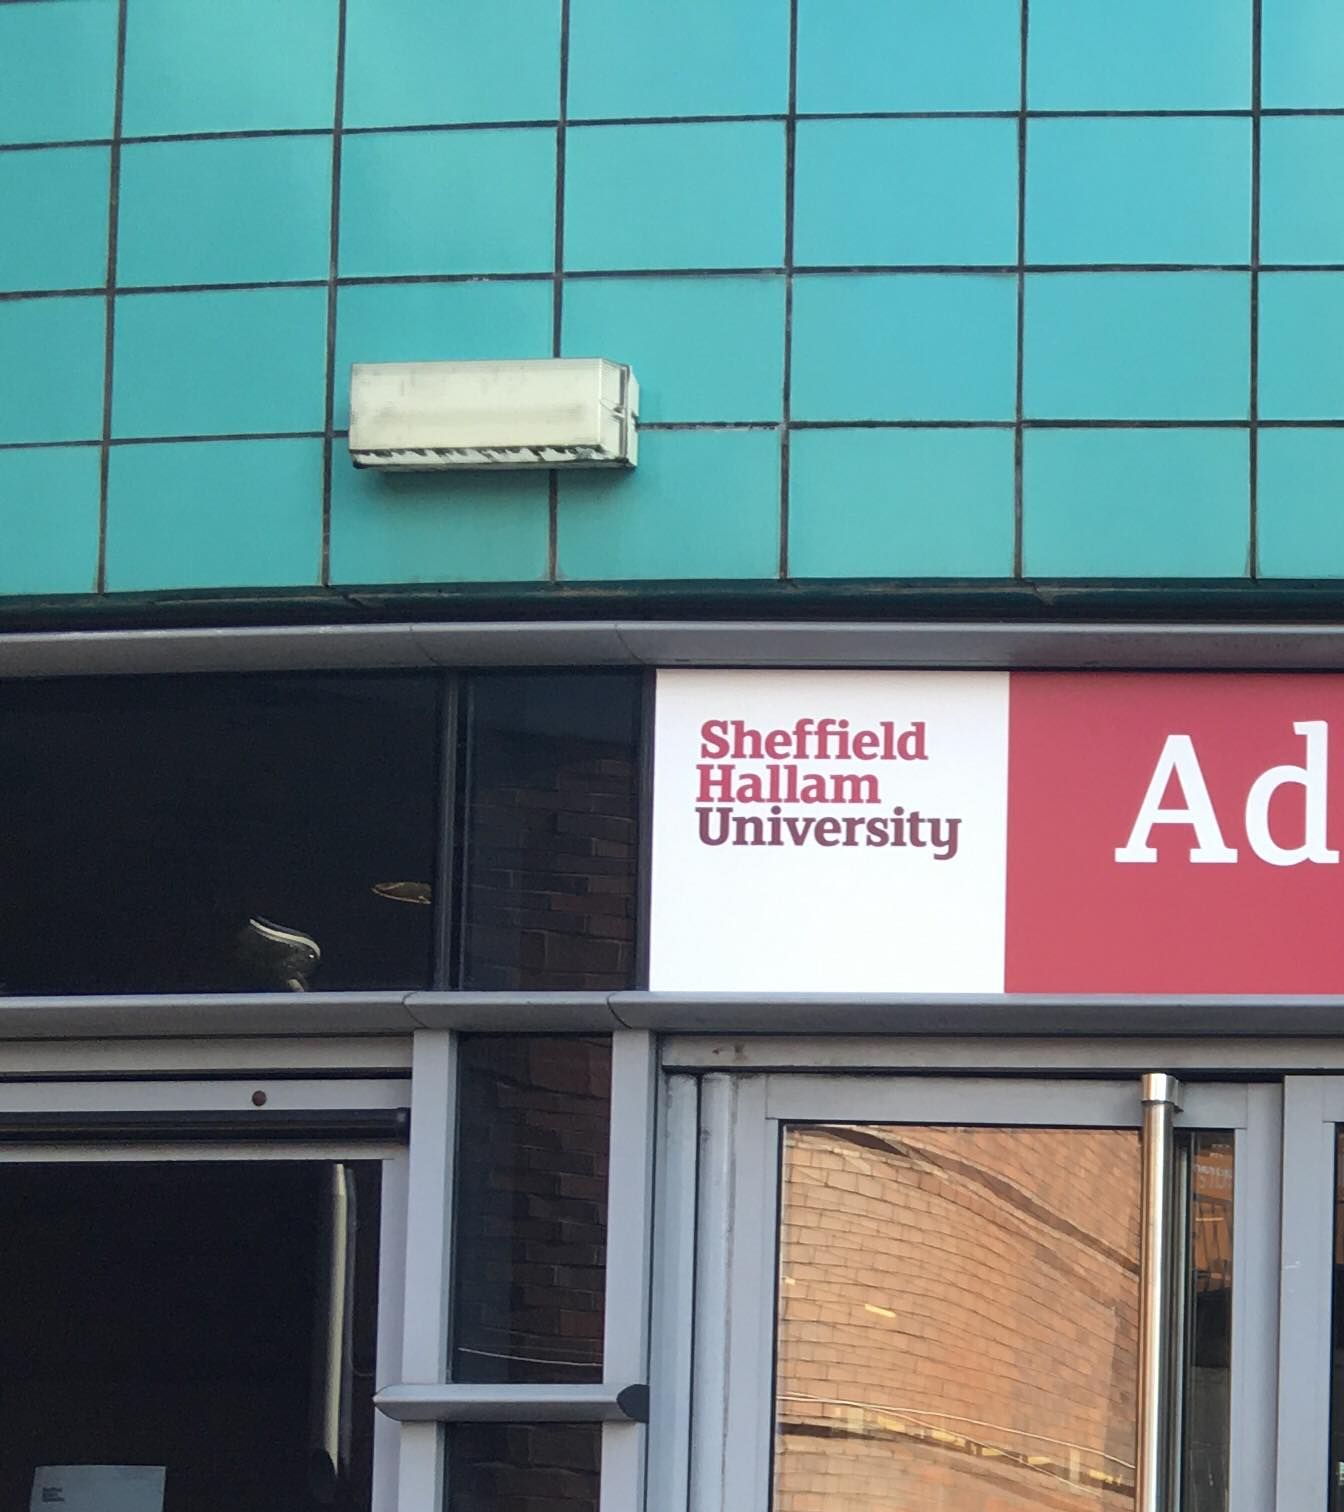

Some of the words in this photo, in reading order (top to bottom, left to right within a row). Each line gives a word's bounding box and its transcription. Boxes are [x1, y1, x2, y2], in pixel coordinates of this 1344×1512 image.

[699, 718, 928, 762] Sheffield
[697, 763, 882, 805] Hallam
[697, 806, 961, 861] University
